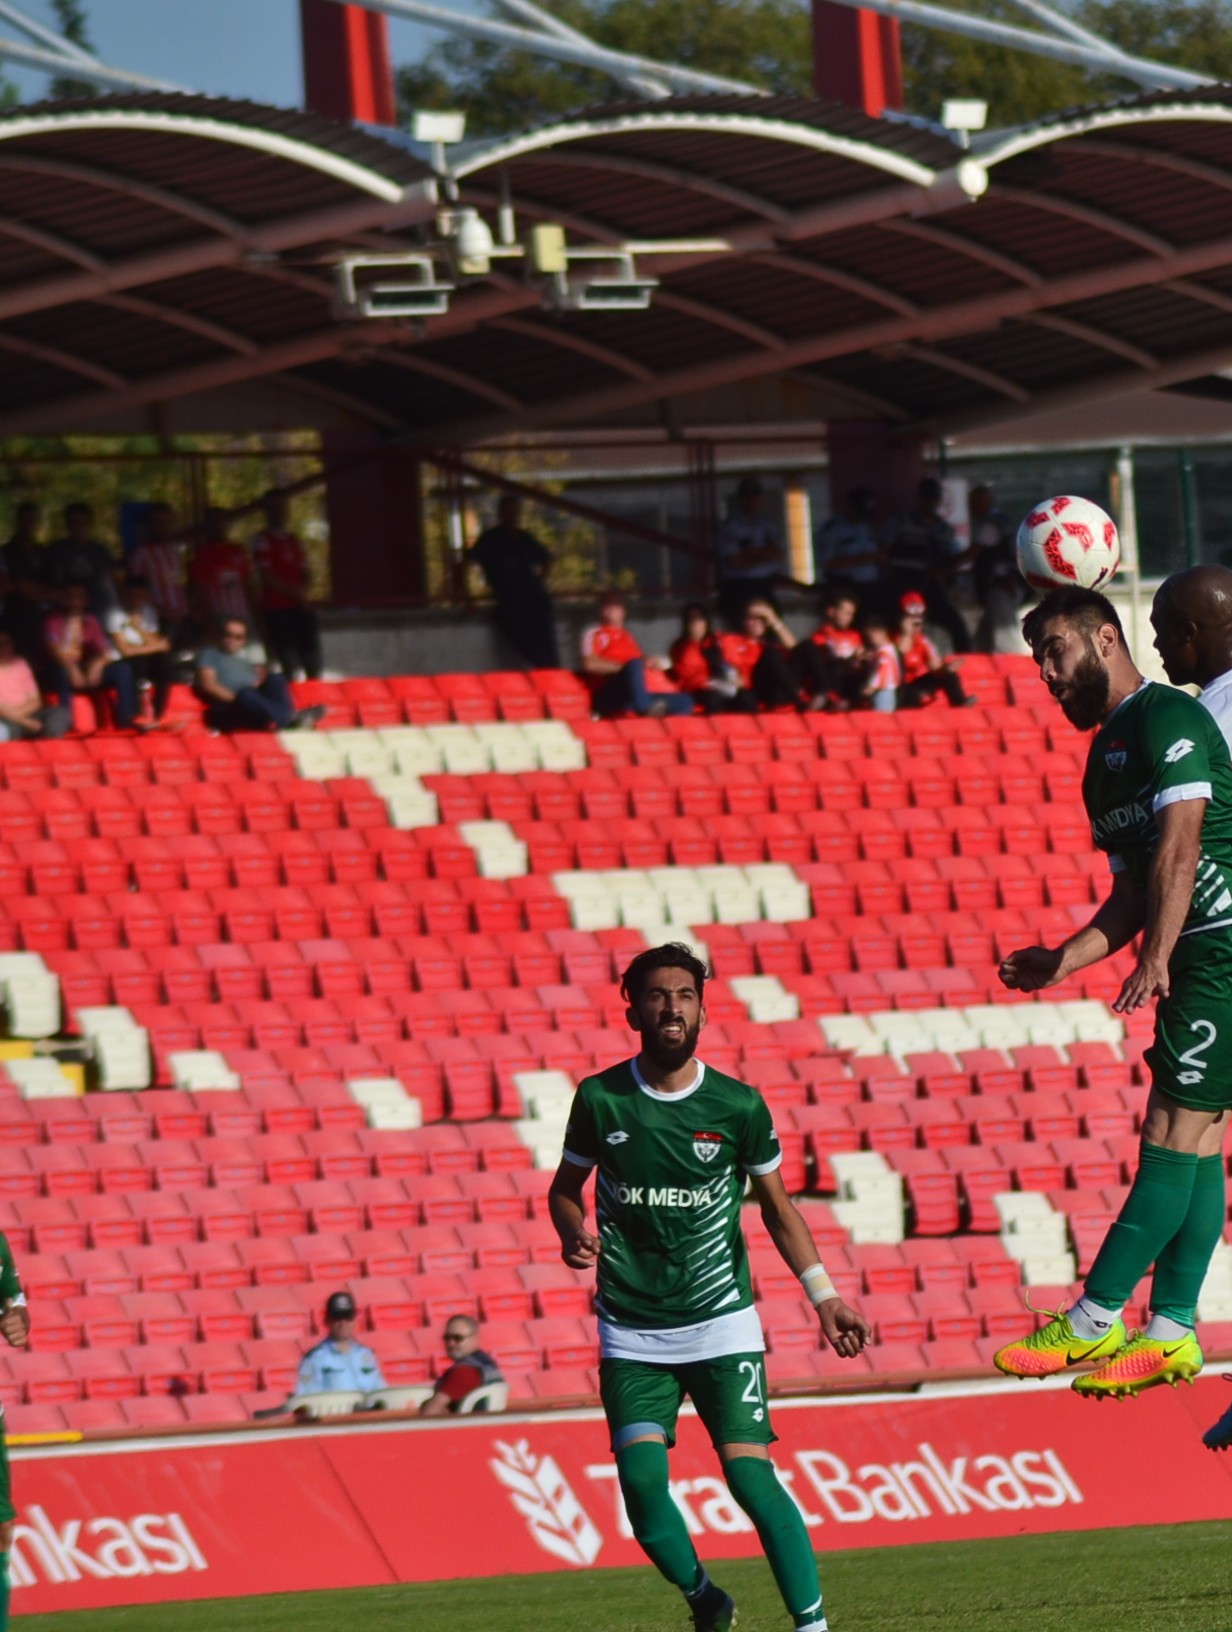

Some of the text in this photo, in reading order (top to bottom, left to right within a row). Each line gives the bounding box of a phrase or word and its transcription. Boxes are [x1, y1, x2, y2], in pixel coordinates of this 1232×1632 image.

[1178, 1019, 1217, 1068] 2
[647, 1187, 713, 1208] MEDYA
[794, 1442, 1084, 1523] Bankası
[9, 1504, 208, 1588] nkası
